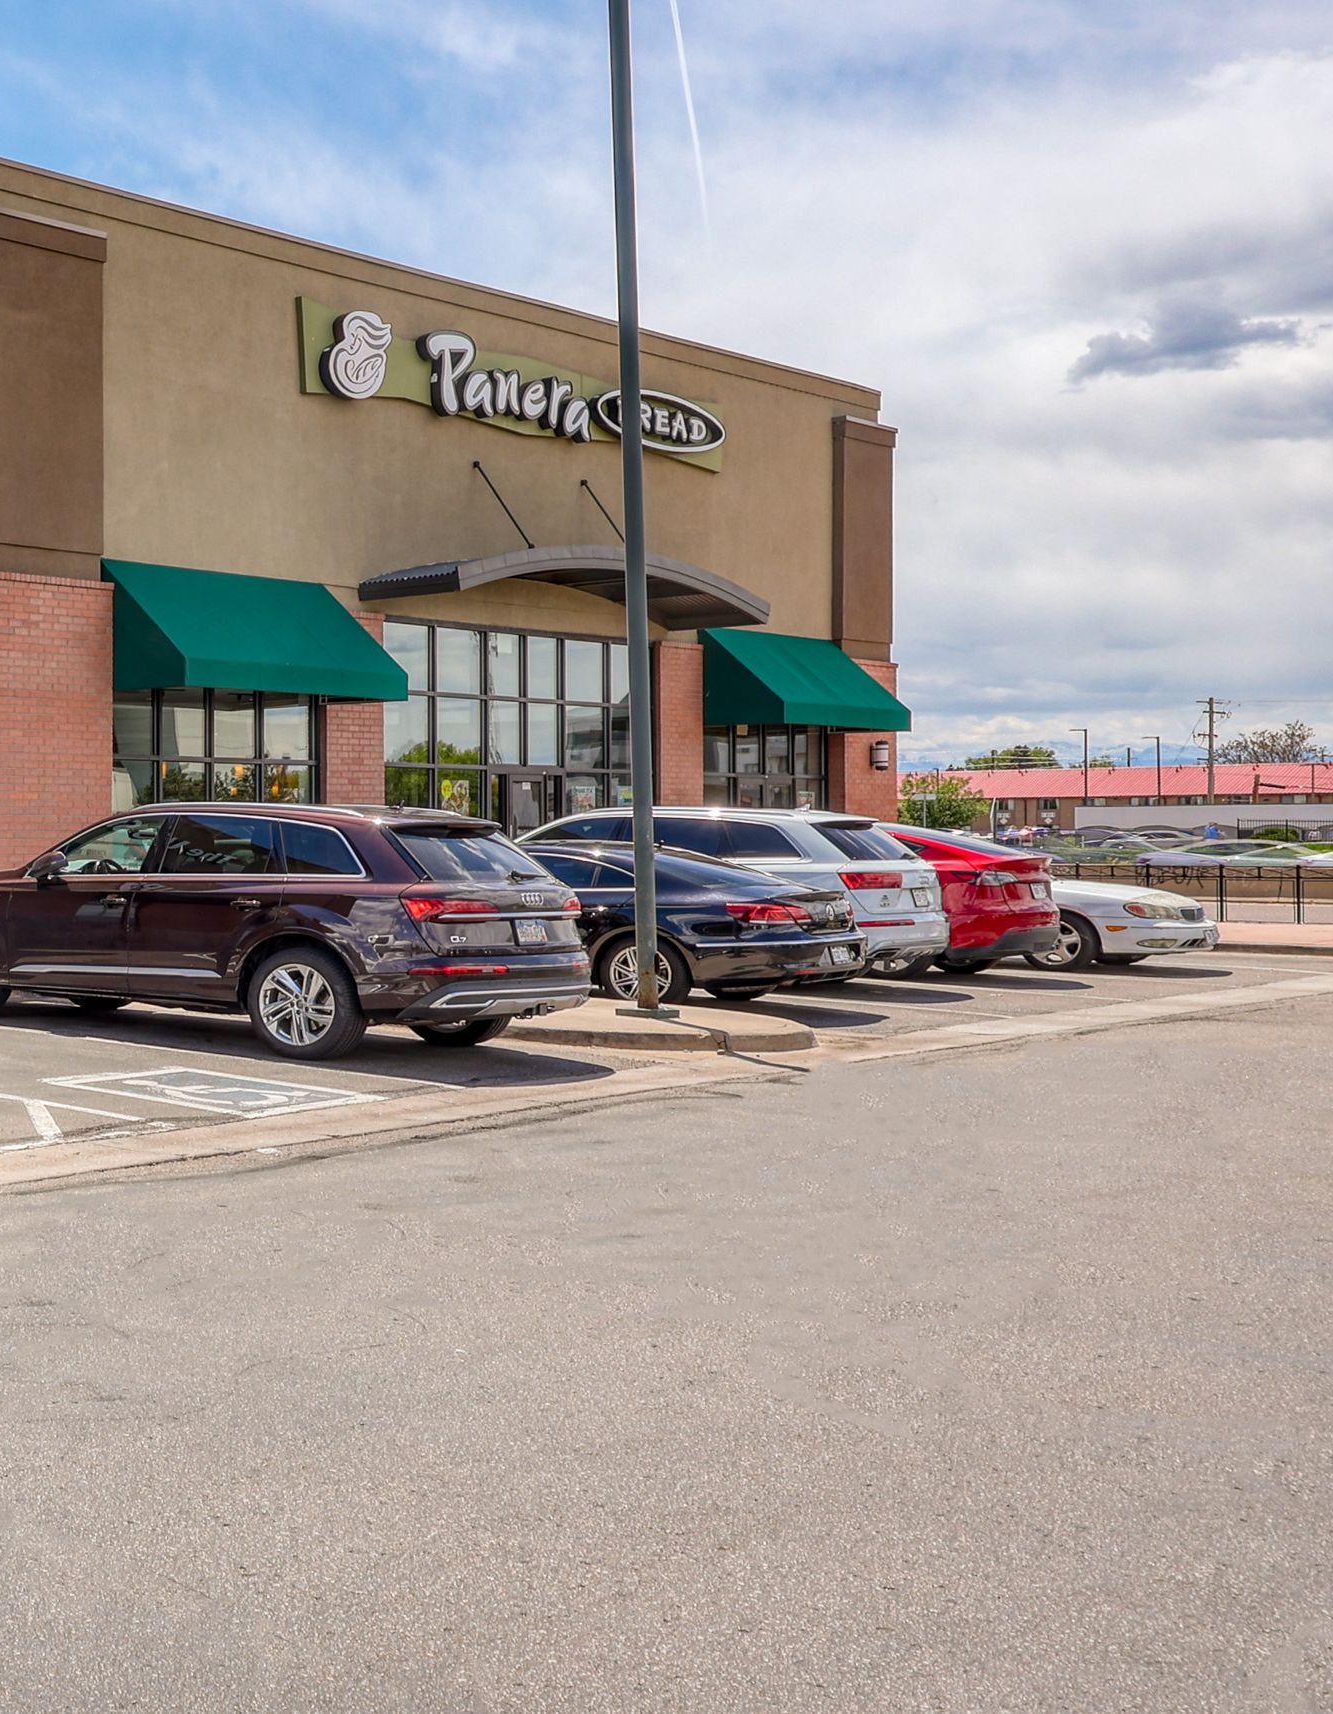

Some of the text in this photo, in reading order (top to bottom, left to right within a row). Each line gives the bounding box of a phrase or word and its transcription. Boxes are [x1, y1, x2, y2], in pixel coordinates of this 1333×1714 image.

[416, 330, 709, 443] Panera READ
[450, 935, 466, 943] Q7
